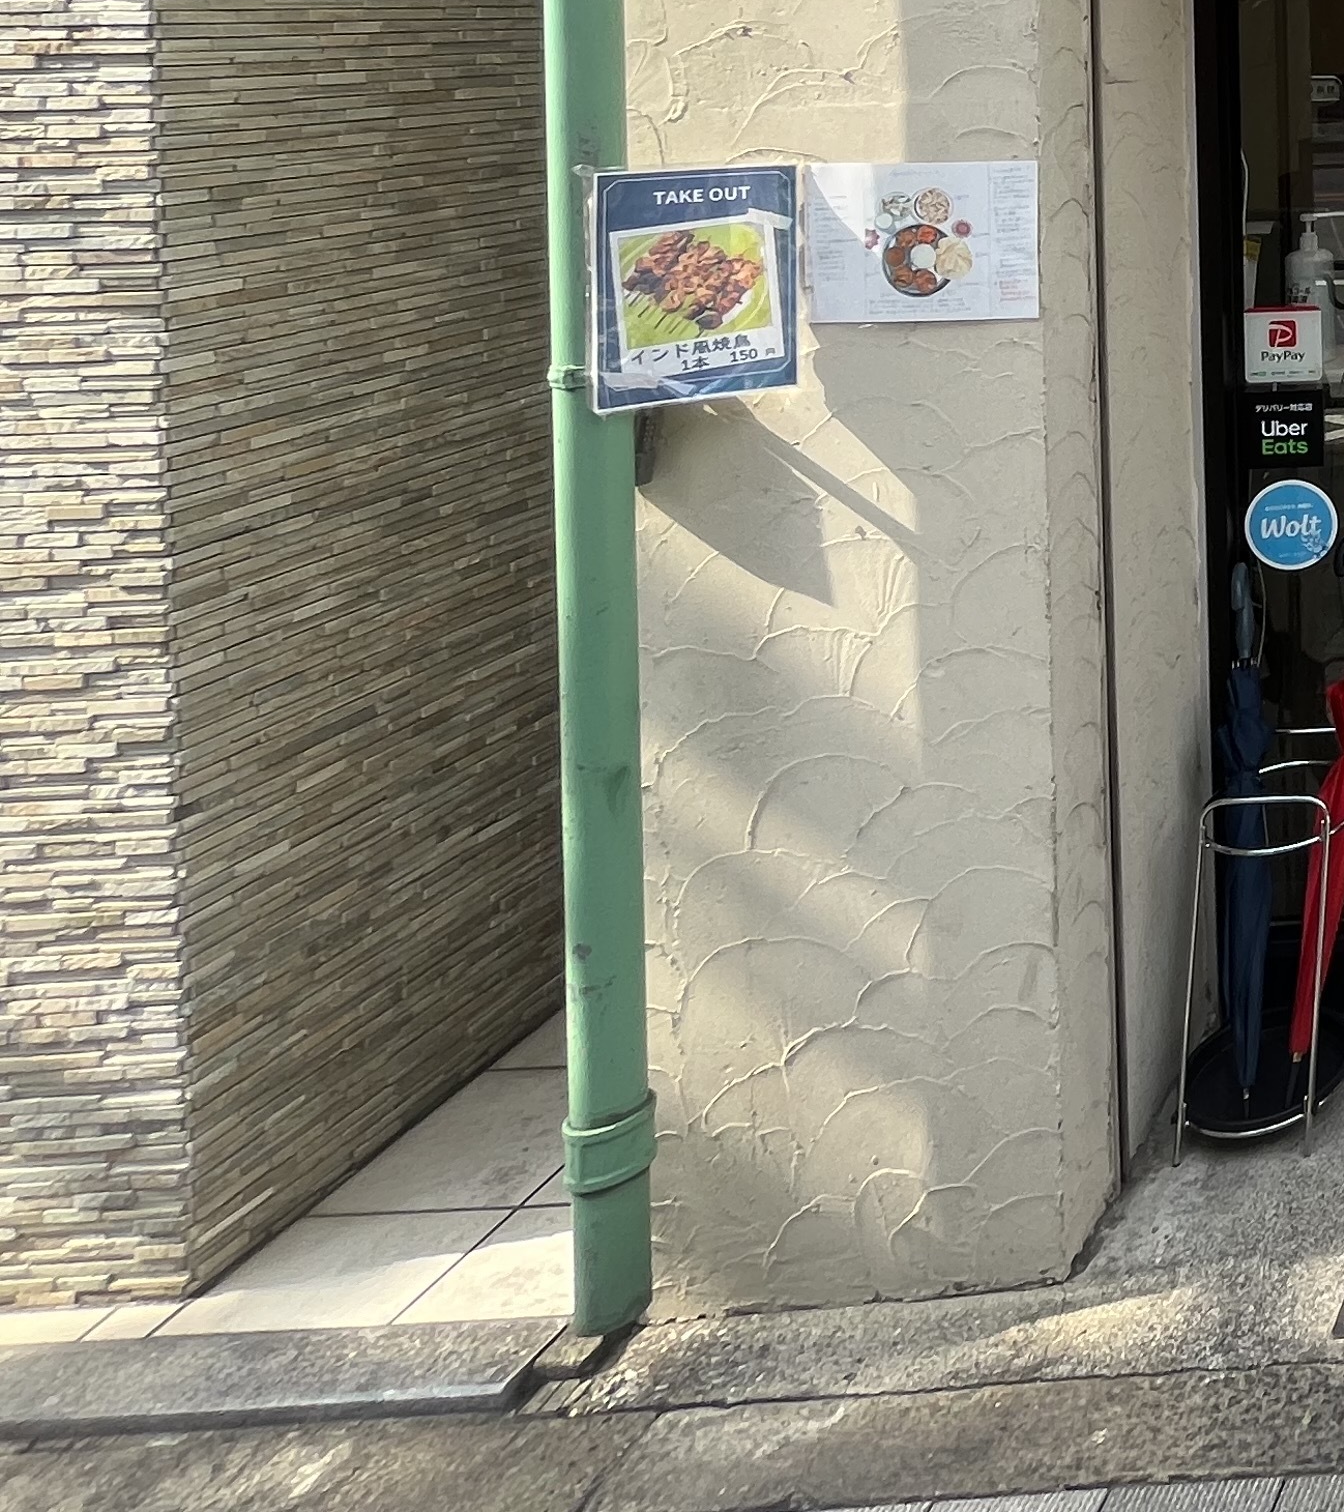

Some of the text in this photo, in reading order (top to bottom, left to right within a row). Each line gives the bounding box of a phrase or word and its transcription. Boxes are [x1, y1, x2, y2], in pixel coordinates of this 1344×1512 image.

[653, 186, 751, 206] TAKE OUT
[631, 335, 751, 365] インド風焼鳥
[730, 348, 758, 363] 150
[1260, 350, 1306, 363] PayPay
[1261, 420, 1308, 437] Uber
[1261, 438, 1309, 456] Eats
[1260, 514, 1322, 539] Wolt
